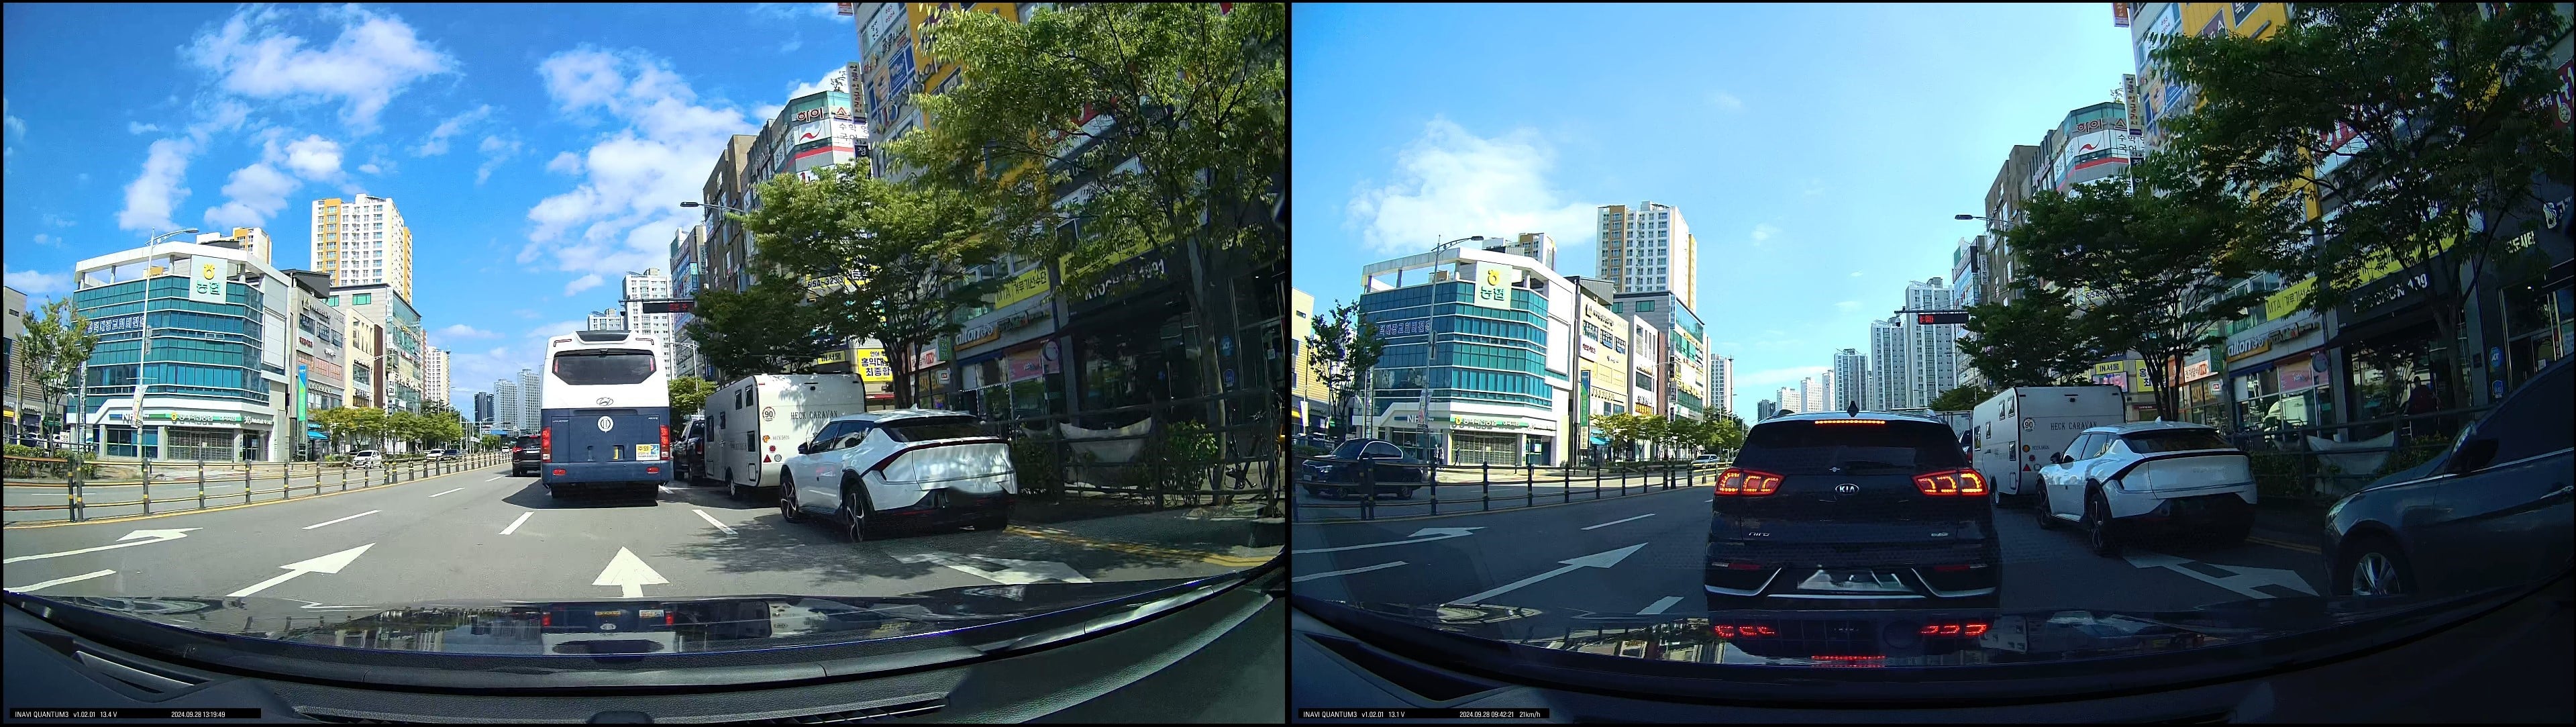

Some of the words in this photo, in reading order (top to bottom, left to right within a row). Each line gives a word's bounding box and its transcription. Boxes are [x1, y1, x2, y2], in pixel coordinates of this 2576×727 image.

[796, 107, 824, 122] 하이
[839, 123, 856, 132] 수학
[2077, 118, 2103, 133] 하이
[2118, 134, 2136, 144] 수학
[197, 281, 221, 295] 농협
[1480, 286, 1505, 301] 농협
[2267, 301, 2281, 314] MTA
[956, 326, 982, 346] alton
[2228, 339, 2251, 356] alton
[2100, 363, 2119, 373] IN서울
[790, 411, 806, 420] HECK
[809, 410, 838, 420] CARAVAN
[2051, 422, 2065, 430] HECK
[2069, 421, 2098, 430] CARAVAN
[1839, 485, 1857, 493] KIA
